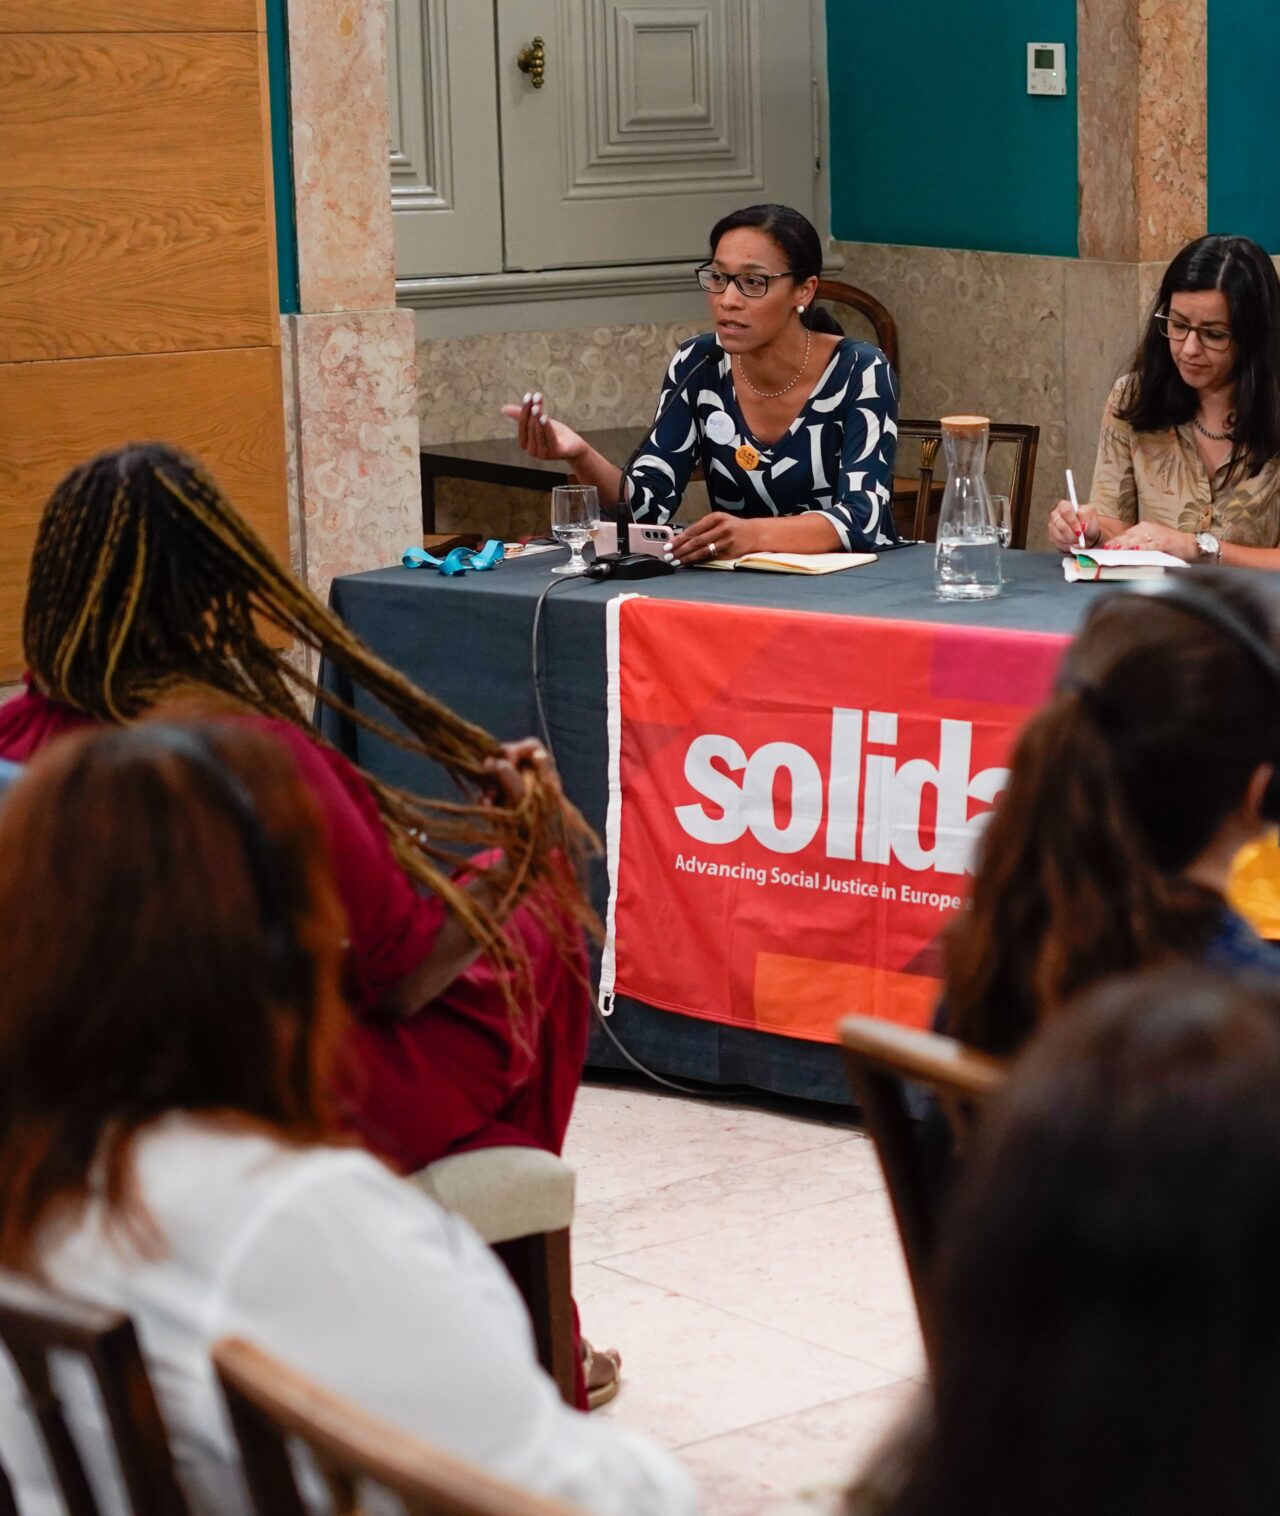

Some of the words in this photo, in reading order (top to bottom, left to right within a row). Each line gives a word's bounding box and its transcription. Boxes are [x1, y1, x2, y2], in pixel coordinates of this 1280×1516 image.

[675, 854, 767, 885] Advancing
[771, 868, 819, 889] Social
[823, 875, 878, 898] Justice
[882, 883, 896, 900] in
[901, 885, 961, 911] Europe
